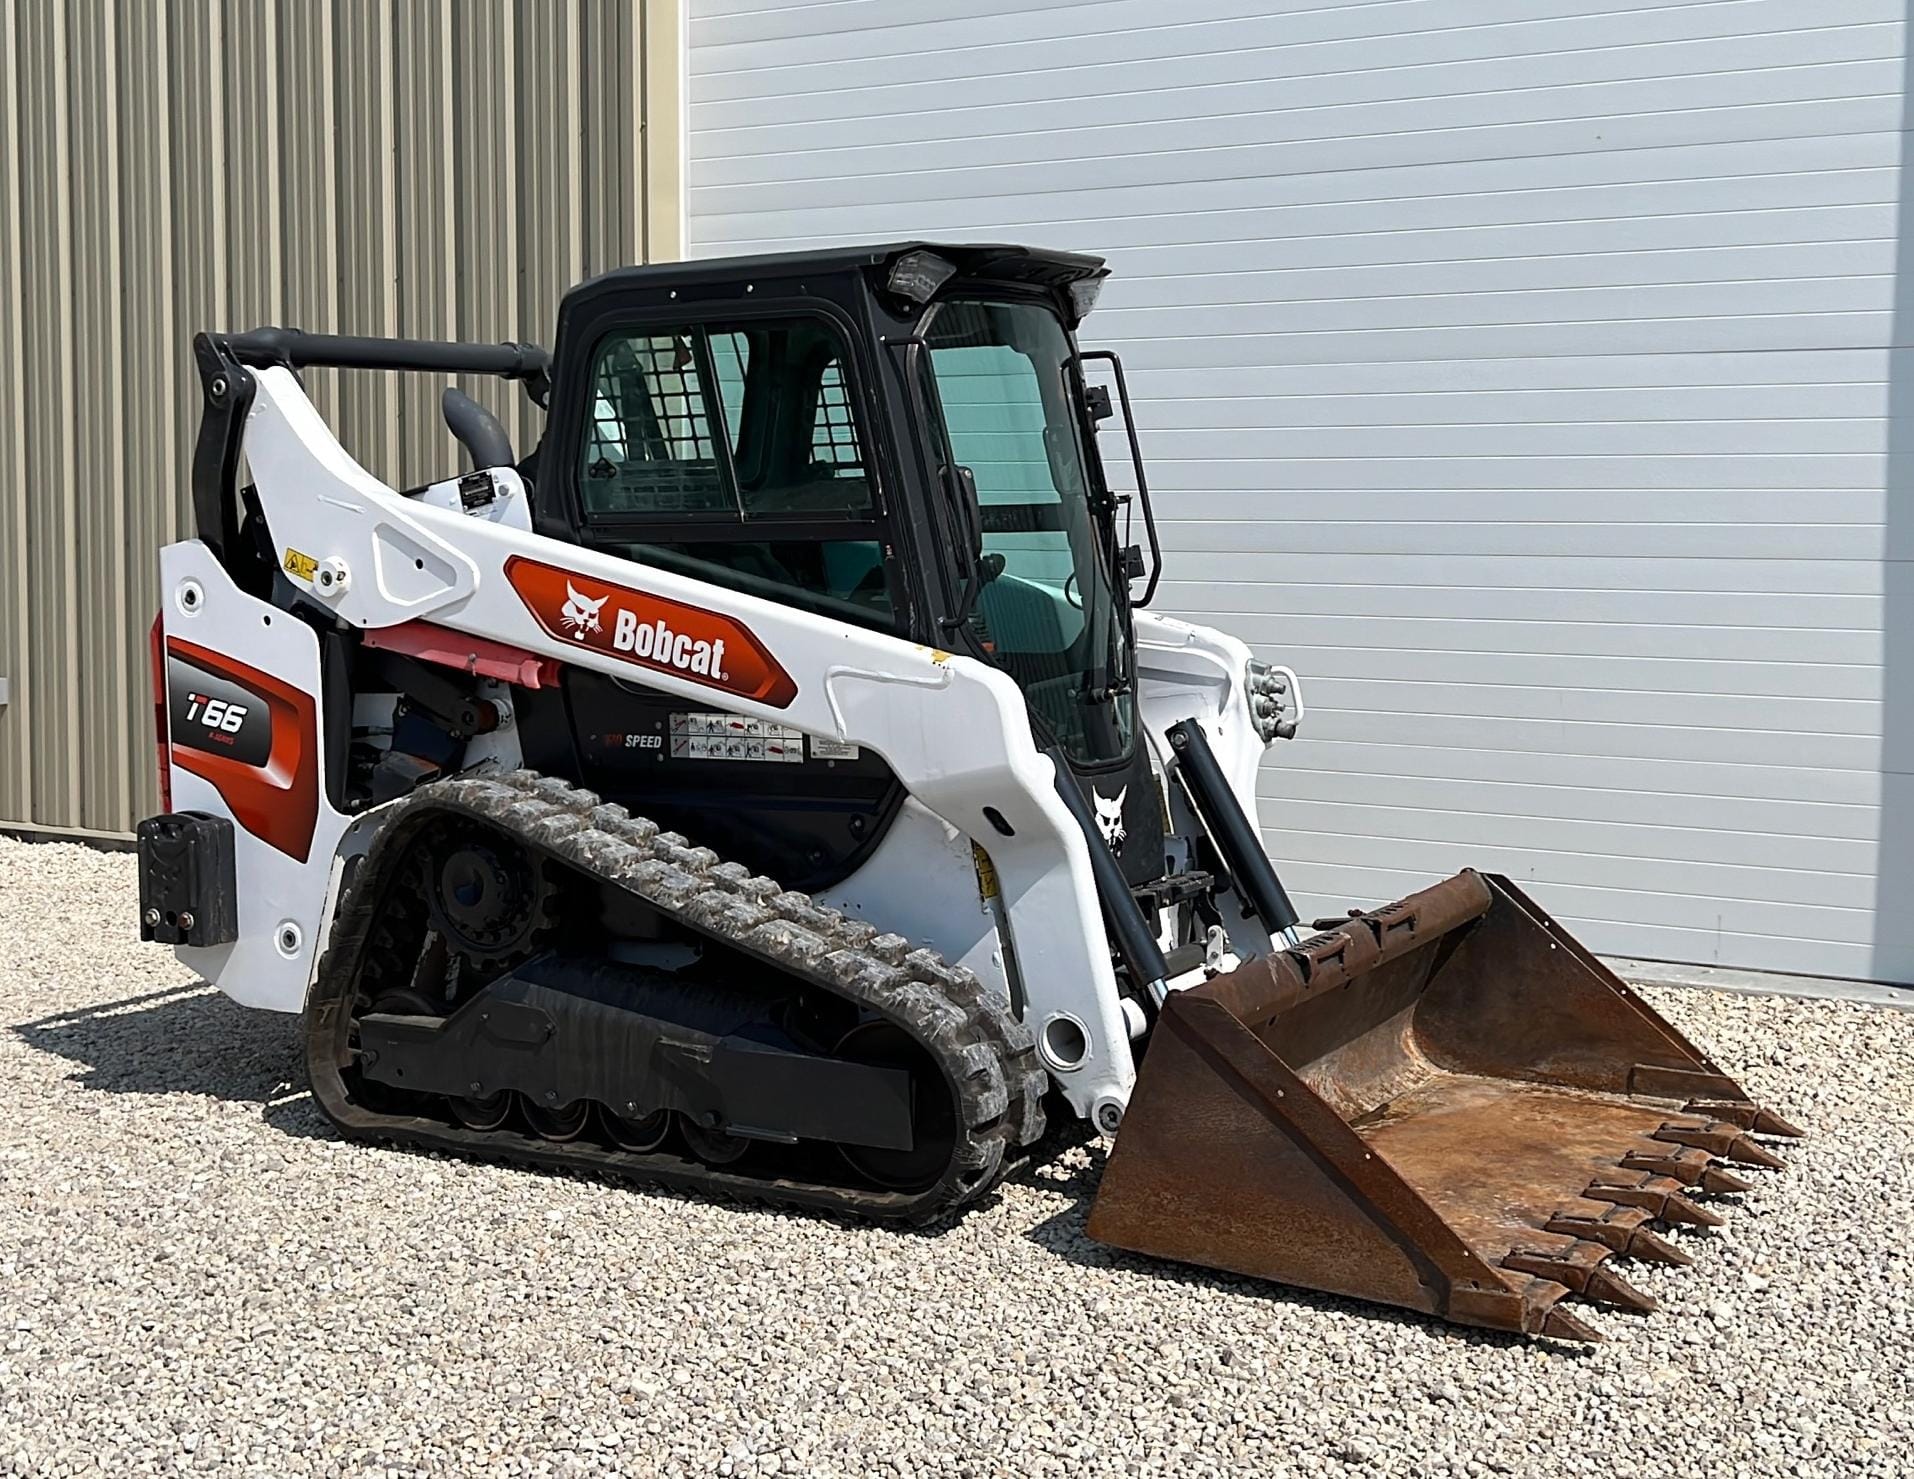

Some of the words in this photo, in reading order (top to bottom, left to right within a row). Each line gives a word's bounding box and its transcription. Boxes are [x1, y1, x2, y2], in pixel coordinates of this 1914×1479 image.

[613, 608, 725, 680] Bobcat
[186, 693, 248, 733] T66
[625, 734, 662, 748] SPEED
